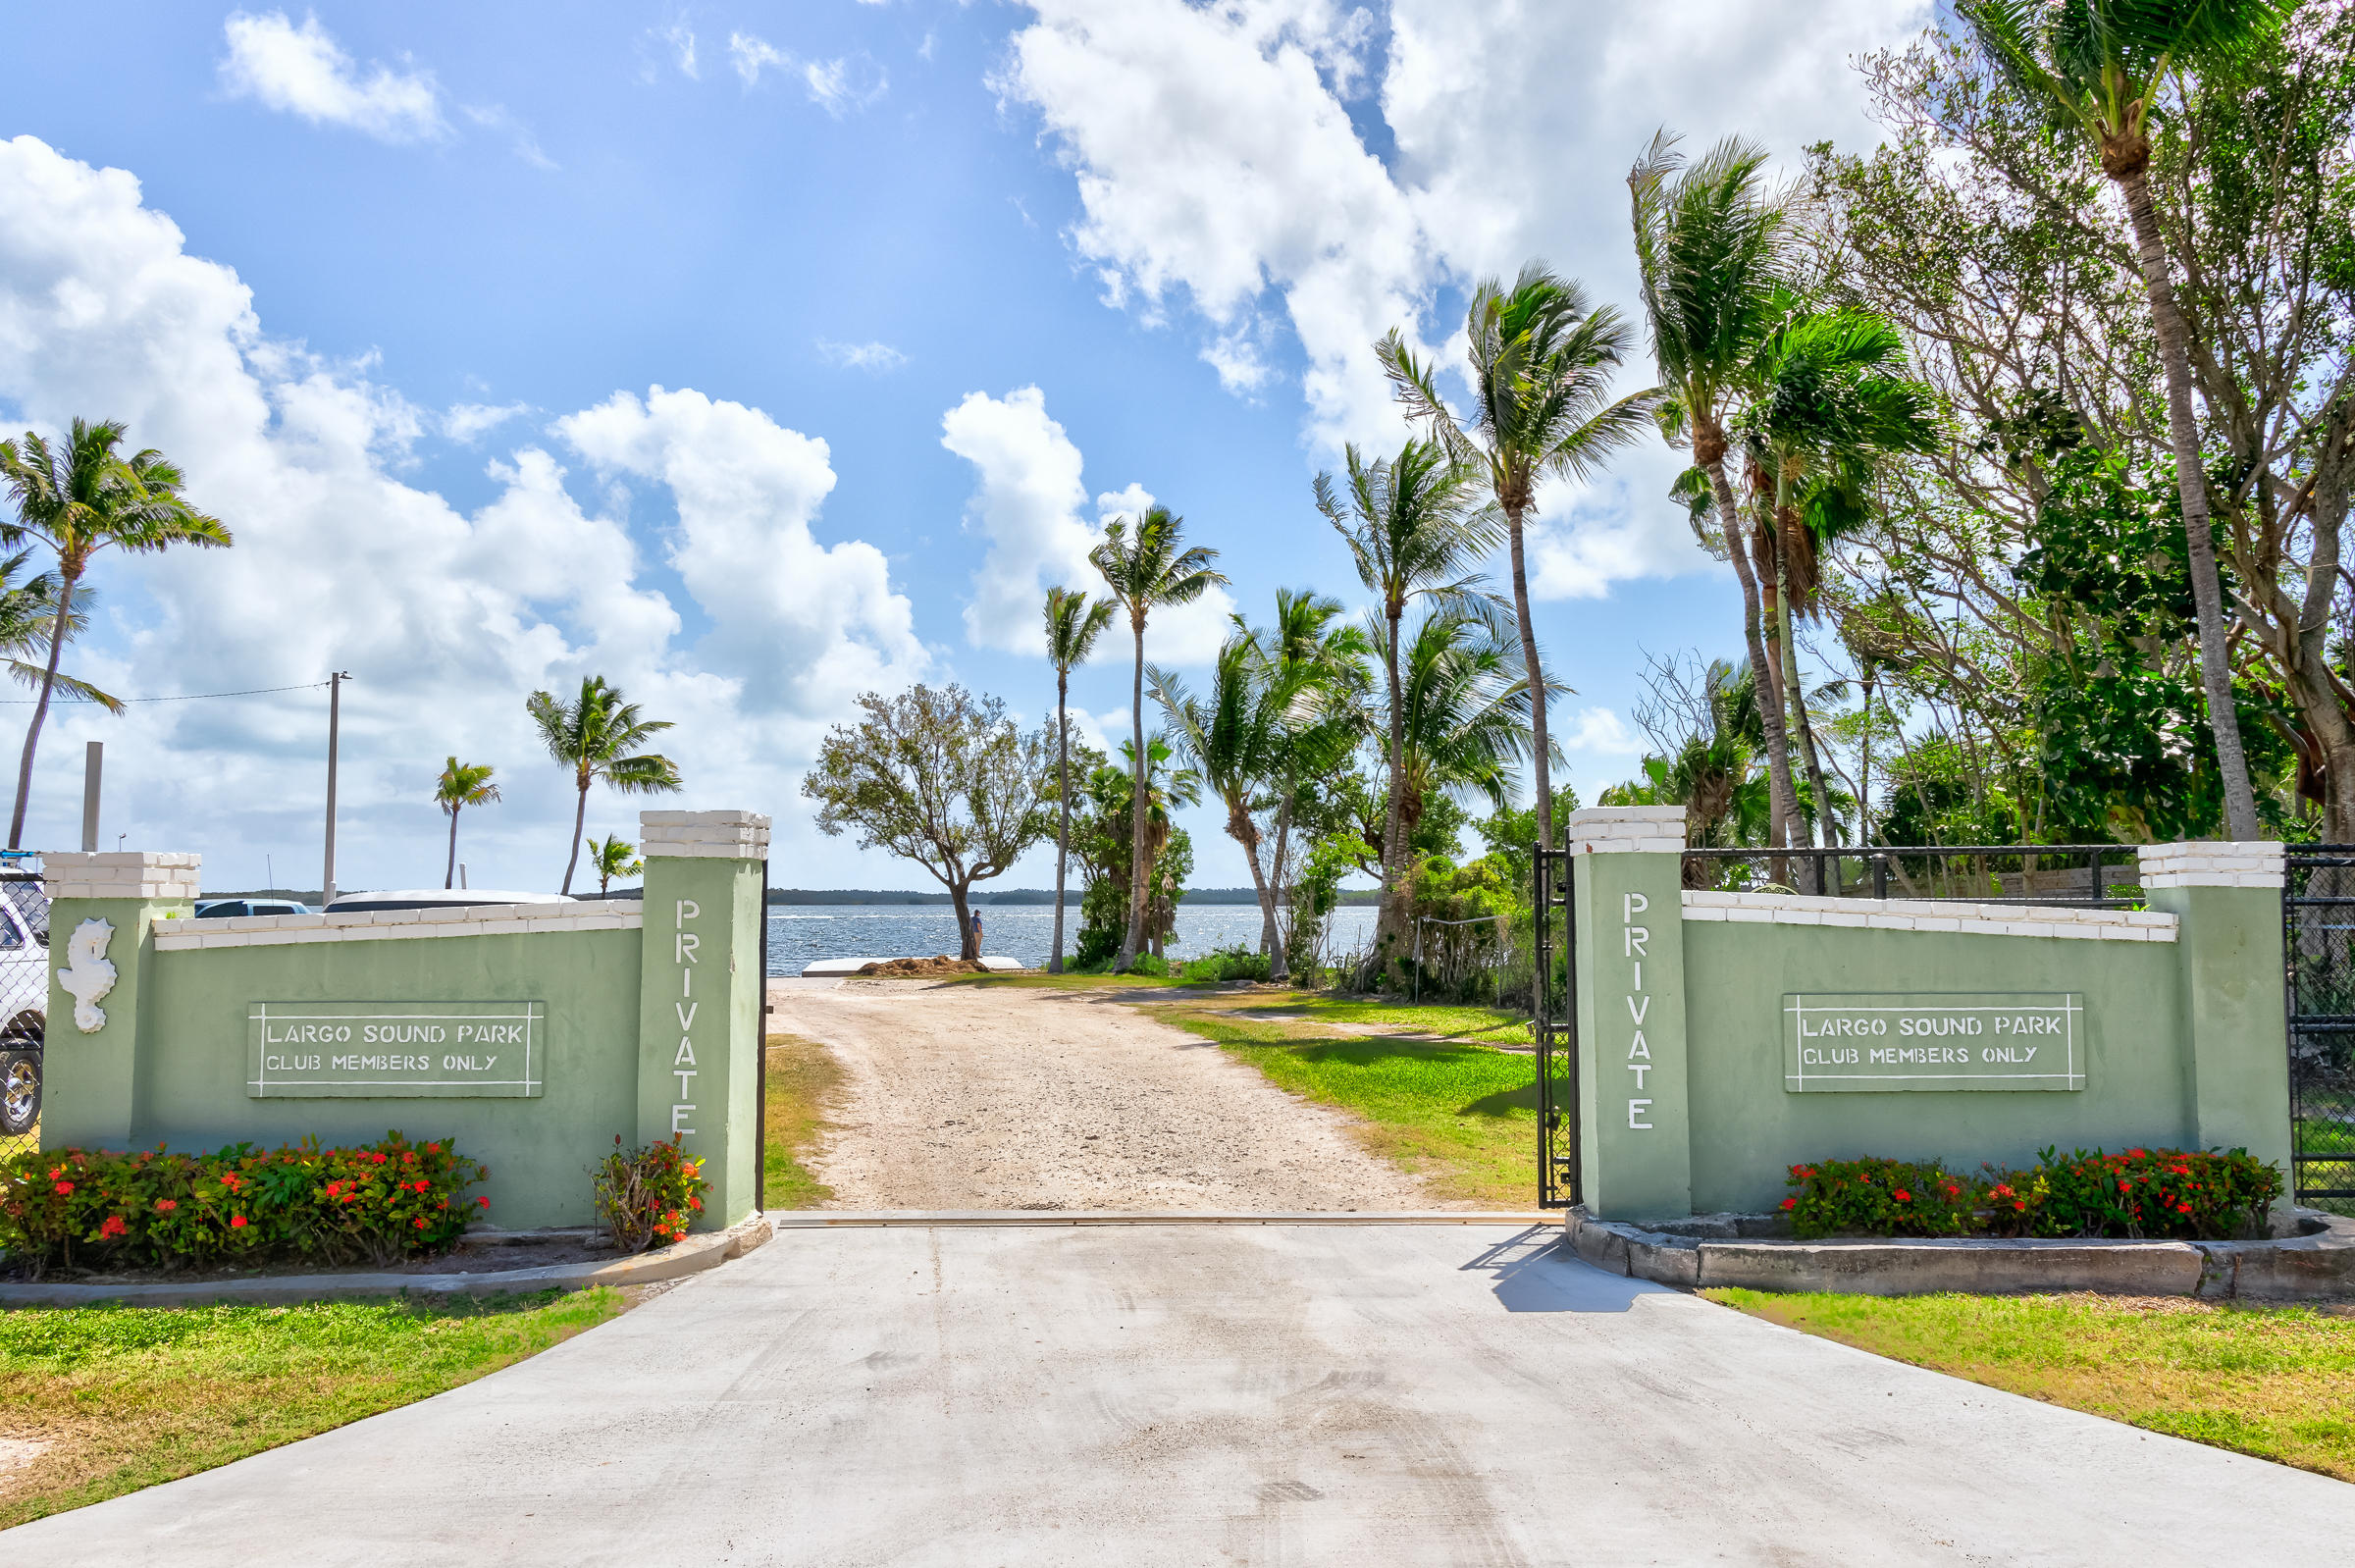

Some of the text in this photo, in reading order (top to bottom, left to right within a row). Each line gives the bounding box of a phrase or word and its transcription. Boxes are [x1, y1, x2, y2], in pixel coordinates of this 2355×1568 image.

[672, 900, 701, 1134] PRIVATE
[1624, 893, 1653, 1129] PRIVATE
[267, 1024, 523, 1044] LARGO SOUND PARK
[1802, 1016, 2062, 1037] LARGO SOUND PARK
[266, 1055, 497, 1071] CLUB MEMBERS ONLY
[1803, 1046, 2037, 1065] CLUB MEMBERS ONLY
